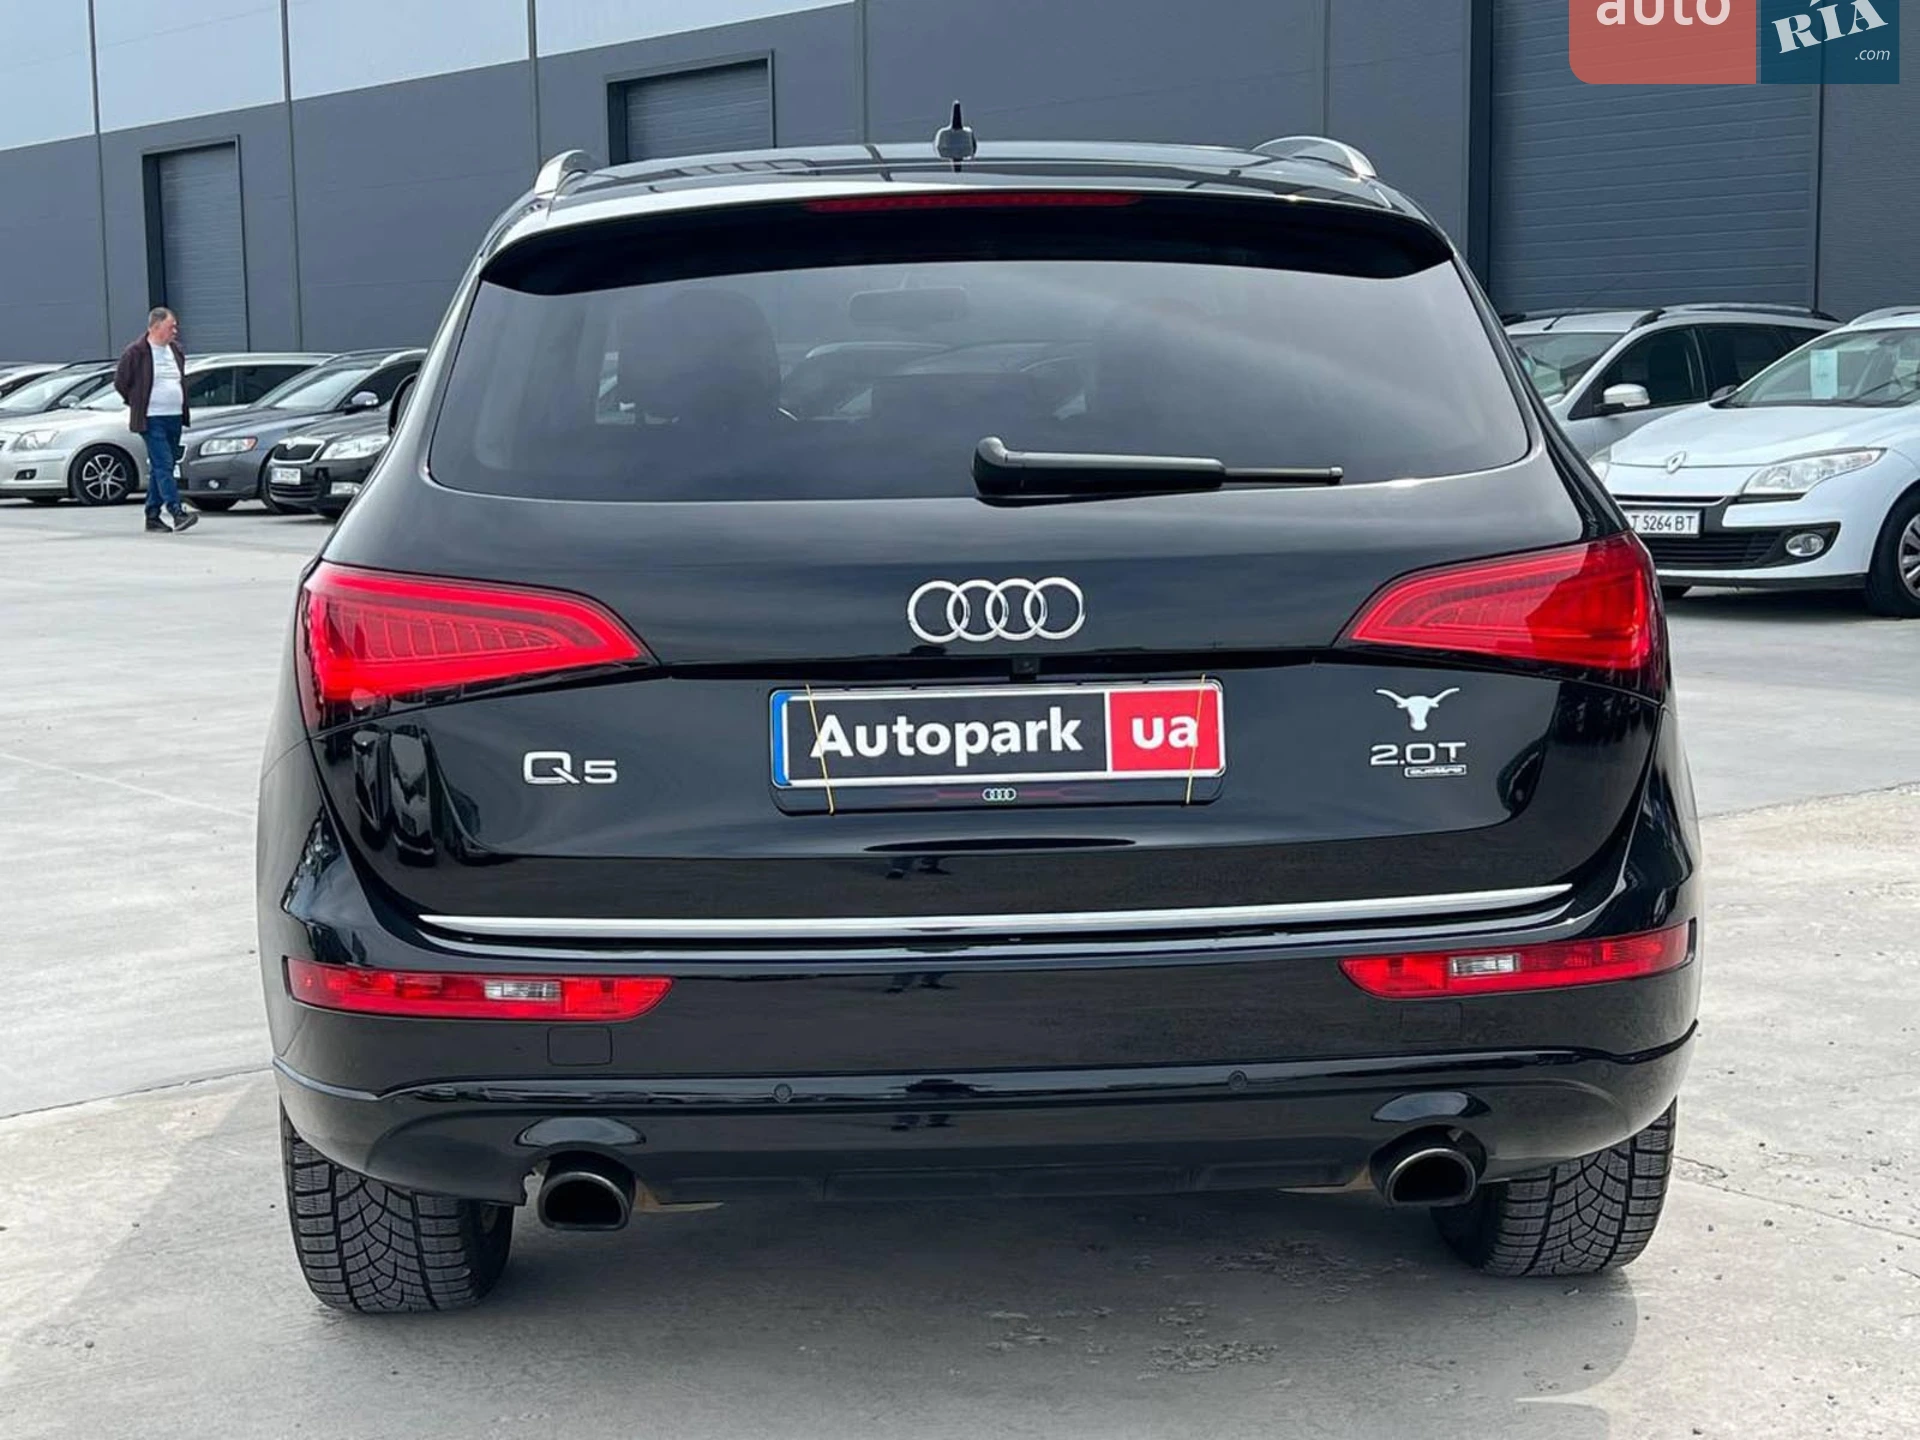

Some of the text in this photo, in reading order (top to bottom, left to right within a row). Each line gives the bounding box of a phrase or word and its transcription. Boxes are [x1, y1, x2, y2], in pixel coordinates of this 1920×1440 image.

[1643, 514, 1672, 531] 5264
[1674, 515, 1696, 531] BT
[810, 706, 1198, 767] Autopark ua
[523, 751, 618, 785] Q5
[1370, 742, 1467, 766] 2.0T
